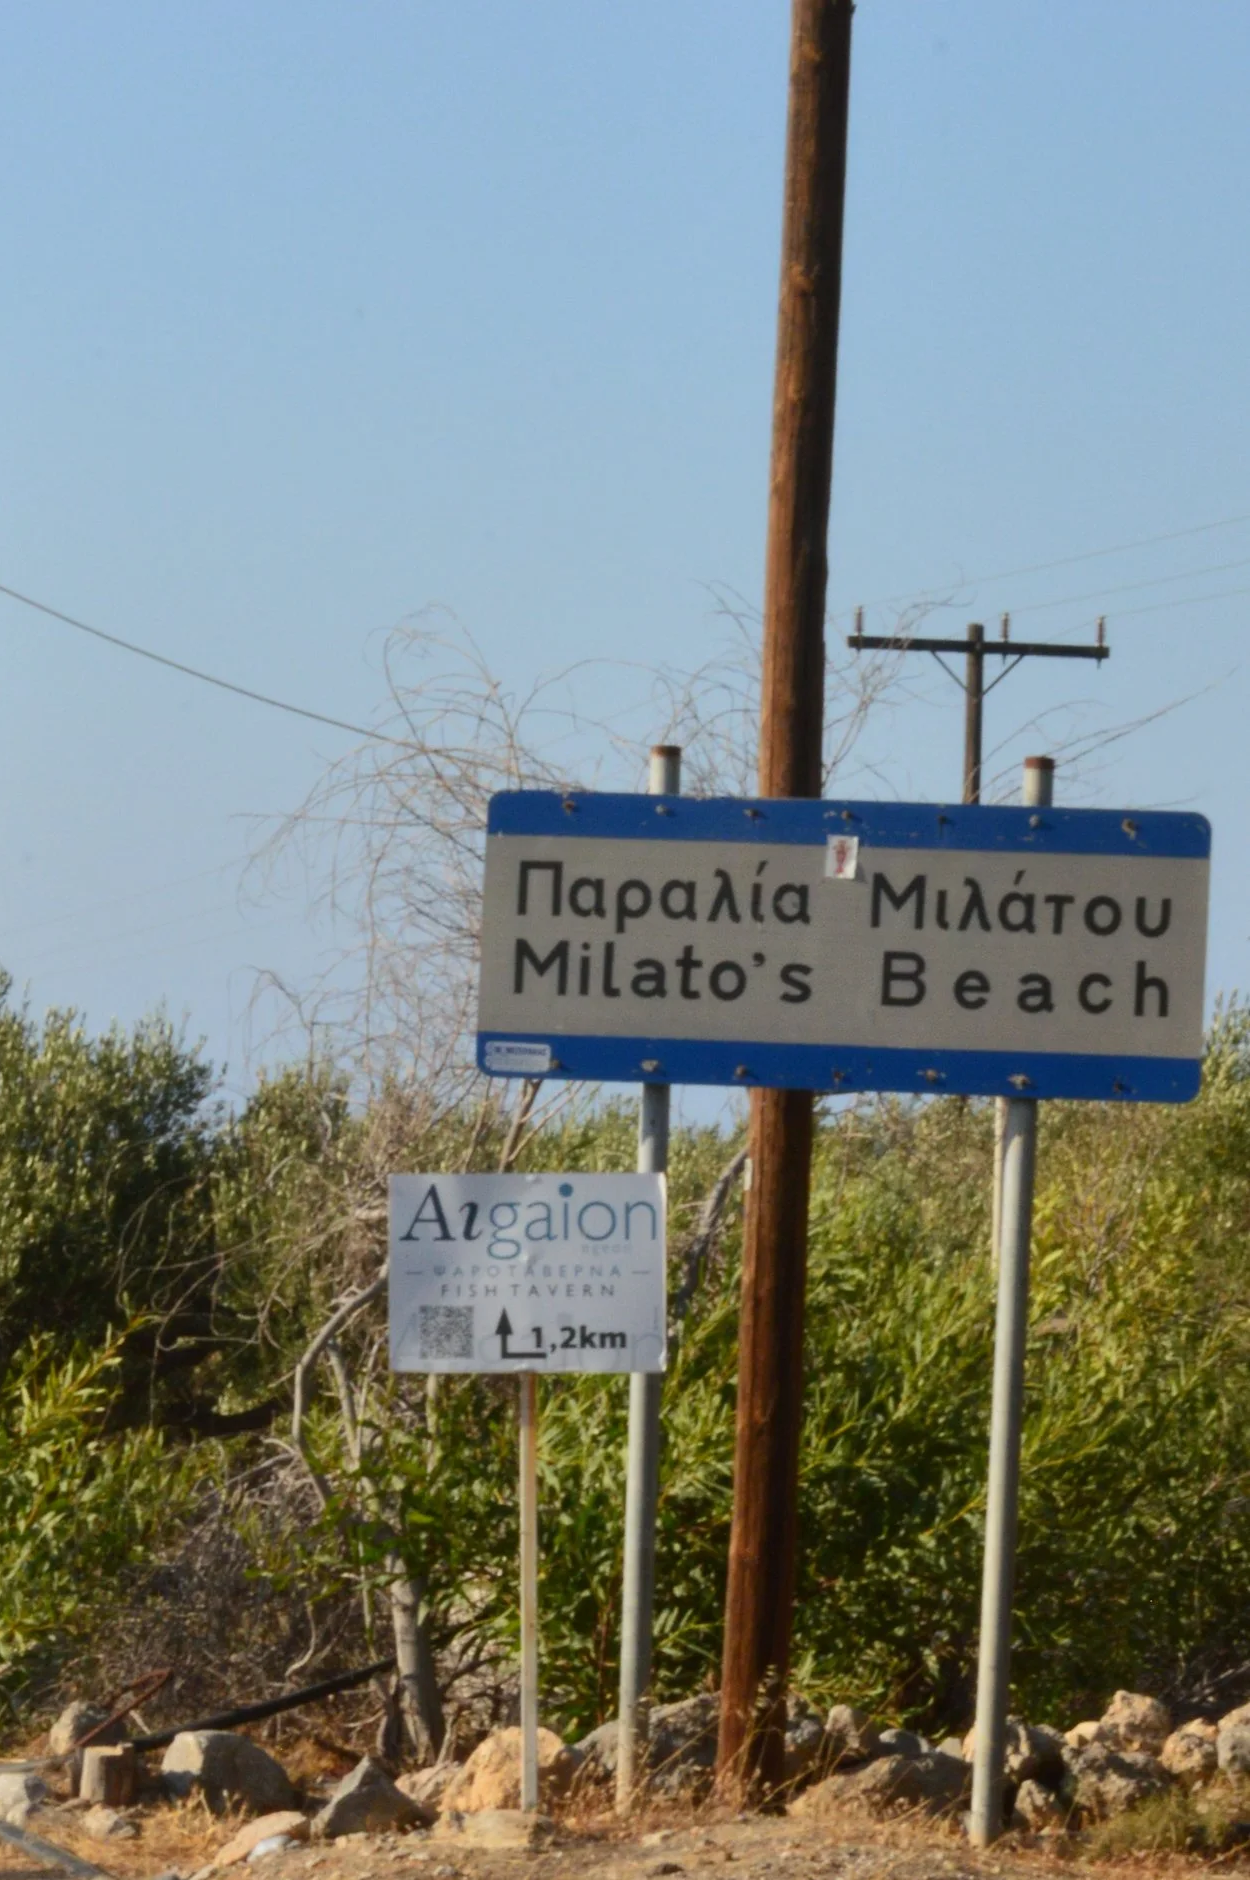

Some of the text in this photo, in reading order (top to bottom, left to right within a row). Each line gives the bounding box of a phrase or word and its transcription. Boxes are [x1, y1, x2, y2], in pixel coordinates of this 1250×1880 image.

[516, 859, 1173, 939] Παραλία Μιλάτου
[512, 938, 1170, 1018] Milato's Beach
[440, 1283, 616, 1297] FISH TAVERN
[530, 1325, 628, 1352] 1,2km
